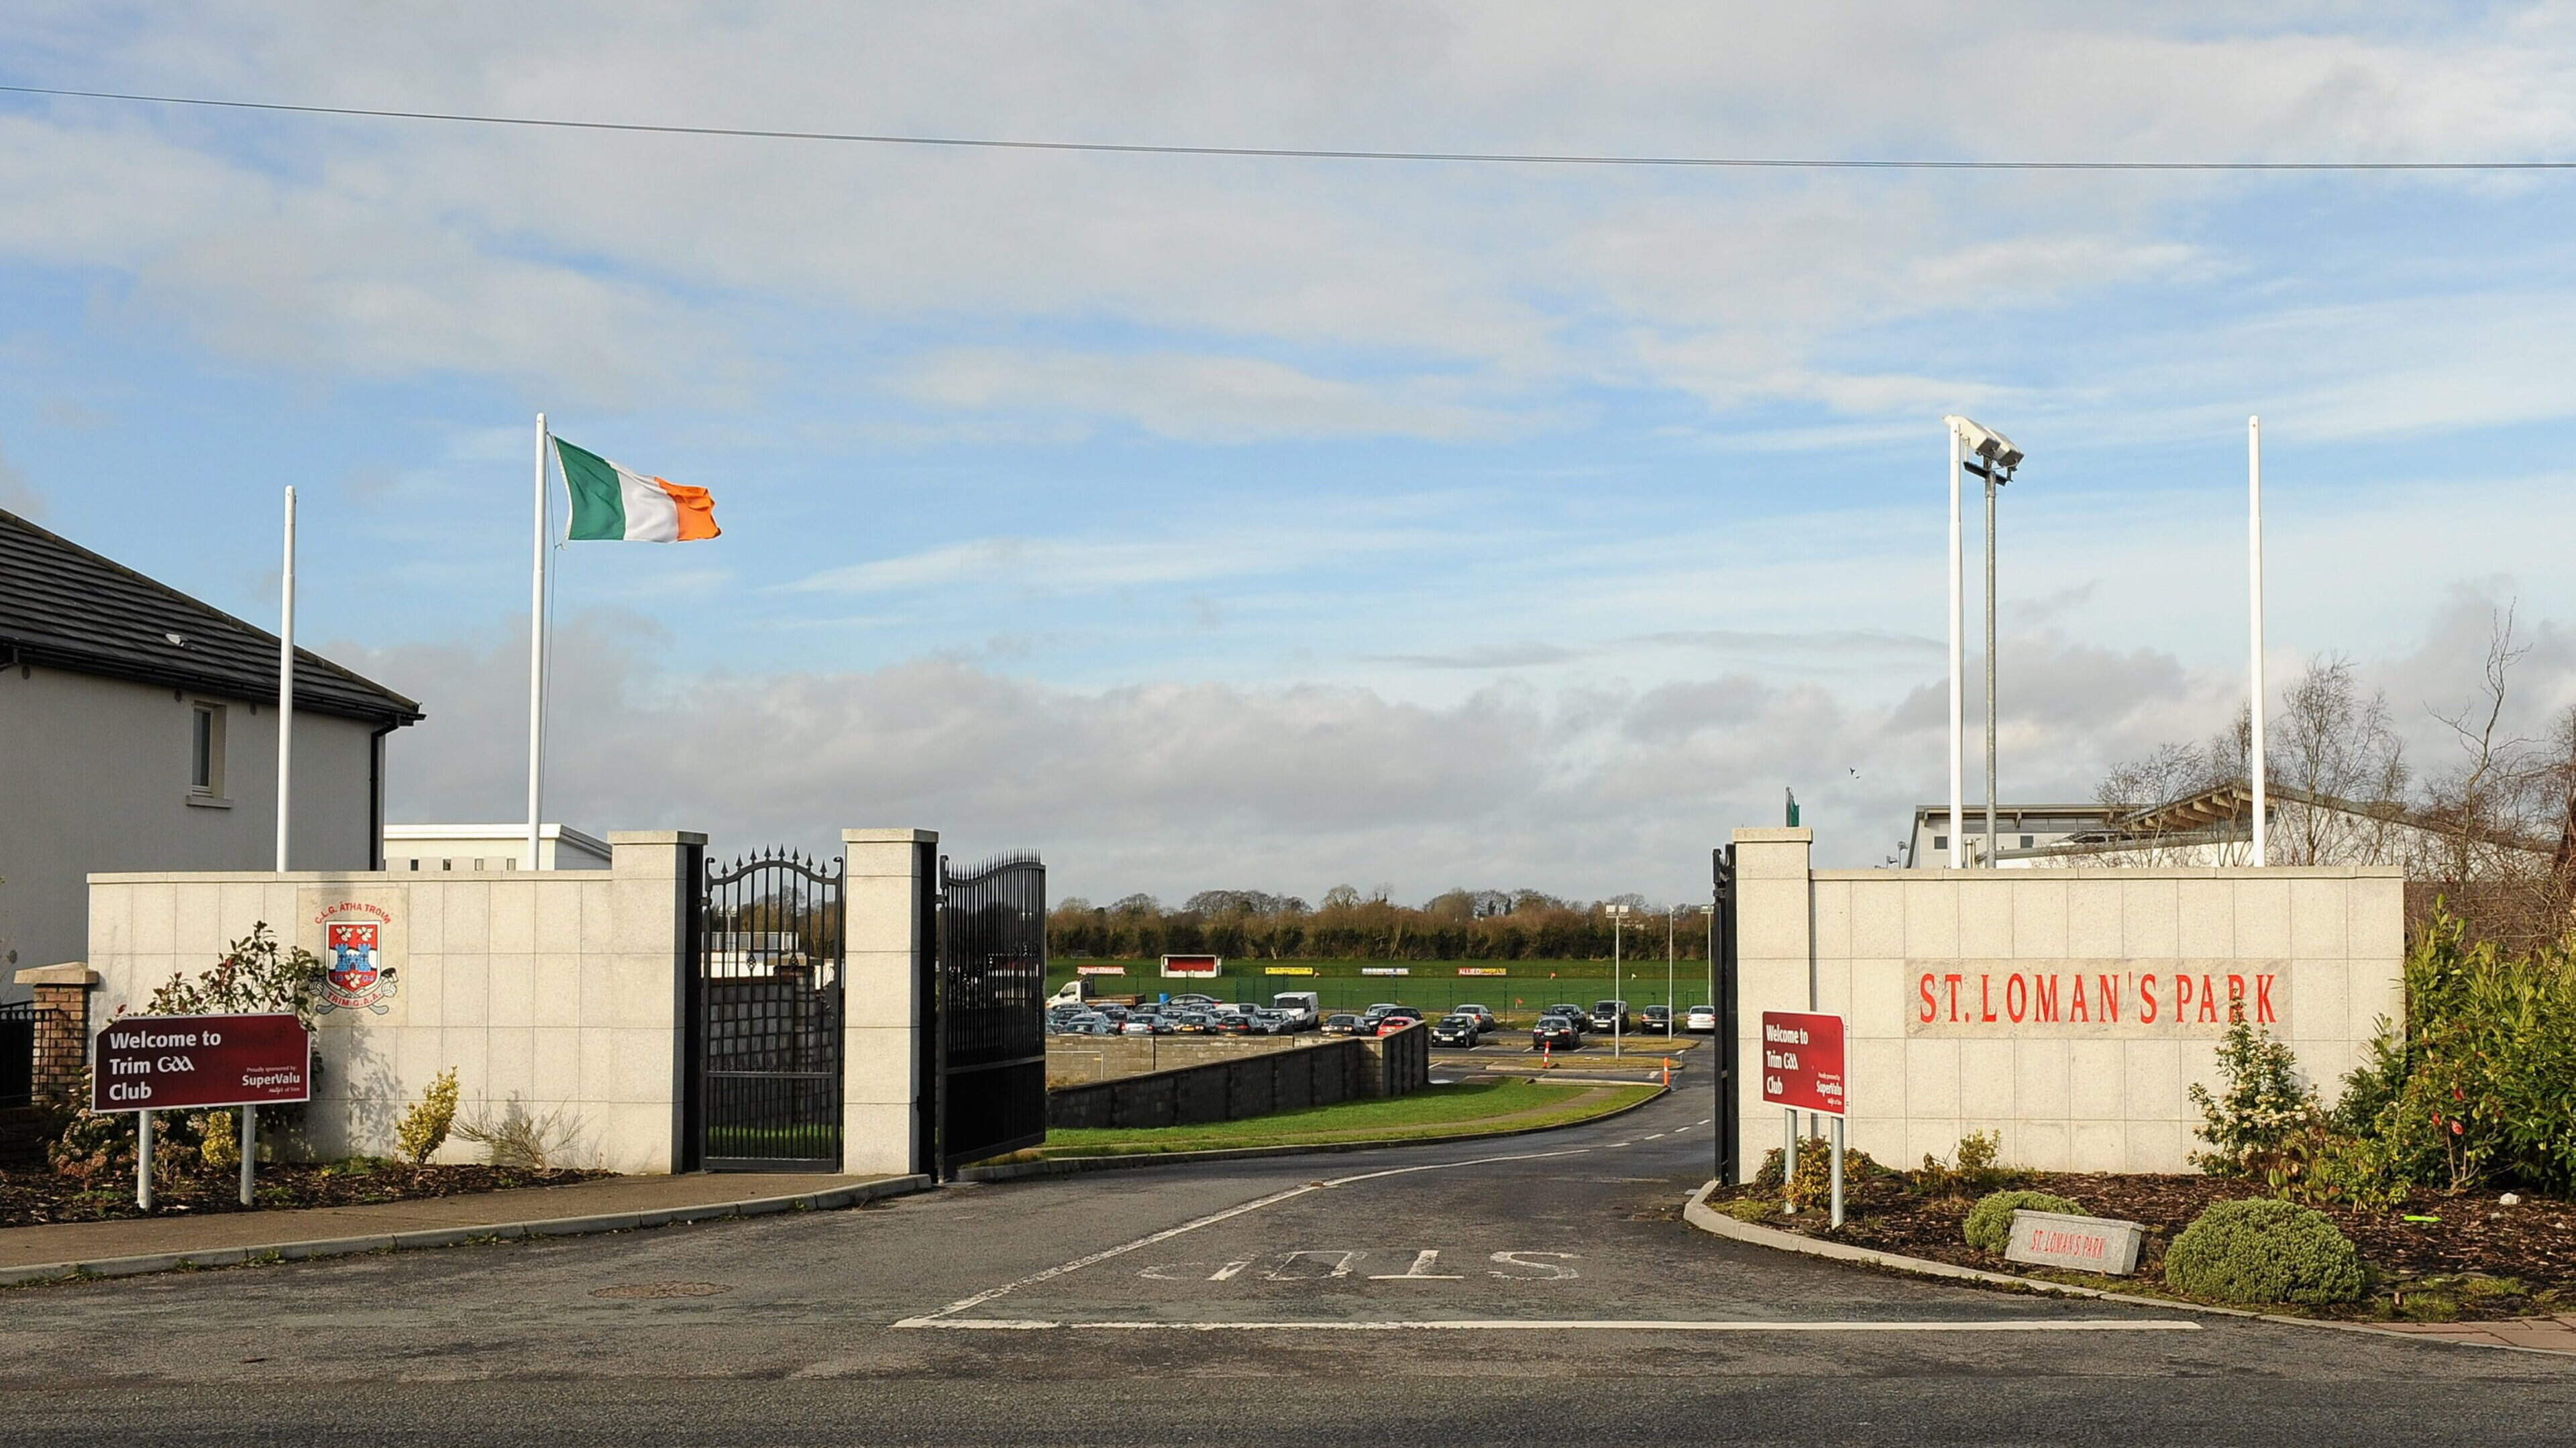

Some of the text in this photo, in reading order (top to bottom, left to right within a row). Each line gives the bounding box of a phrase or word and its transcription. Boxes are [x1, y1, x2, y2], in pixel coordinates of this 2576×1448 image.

[364, 903, 391, 924] TROIM
[326, 991, 382, 1007] TRIM G.A.A.
[2176, 974, 2277, 1023] PARK
[109, 1030, 221, 1049] Welcome to
[1766, 1023, 1809, 1045] Welcome to
[109, 1055, 195, 1074] Trim GAA
[1766, 1050, 1782, 1068] Trim
[242, 1072, 300, 1089] SuperValu
[1766, 1075, 1783, 1095] Club
[1816, 1080, 1843, 1097] SuperValu
[109, 1080, 152, 1101] Club
